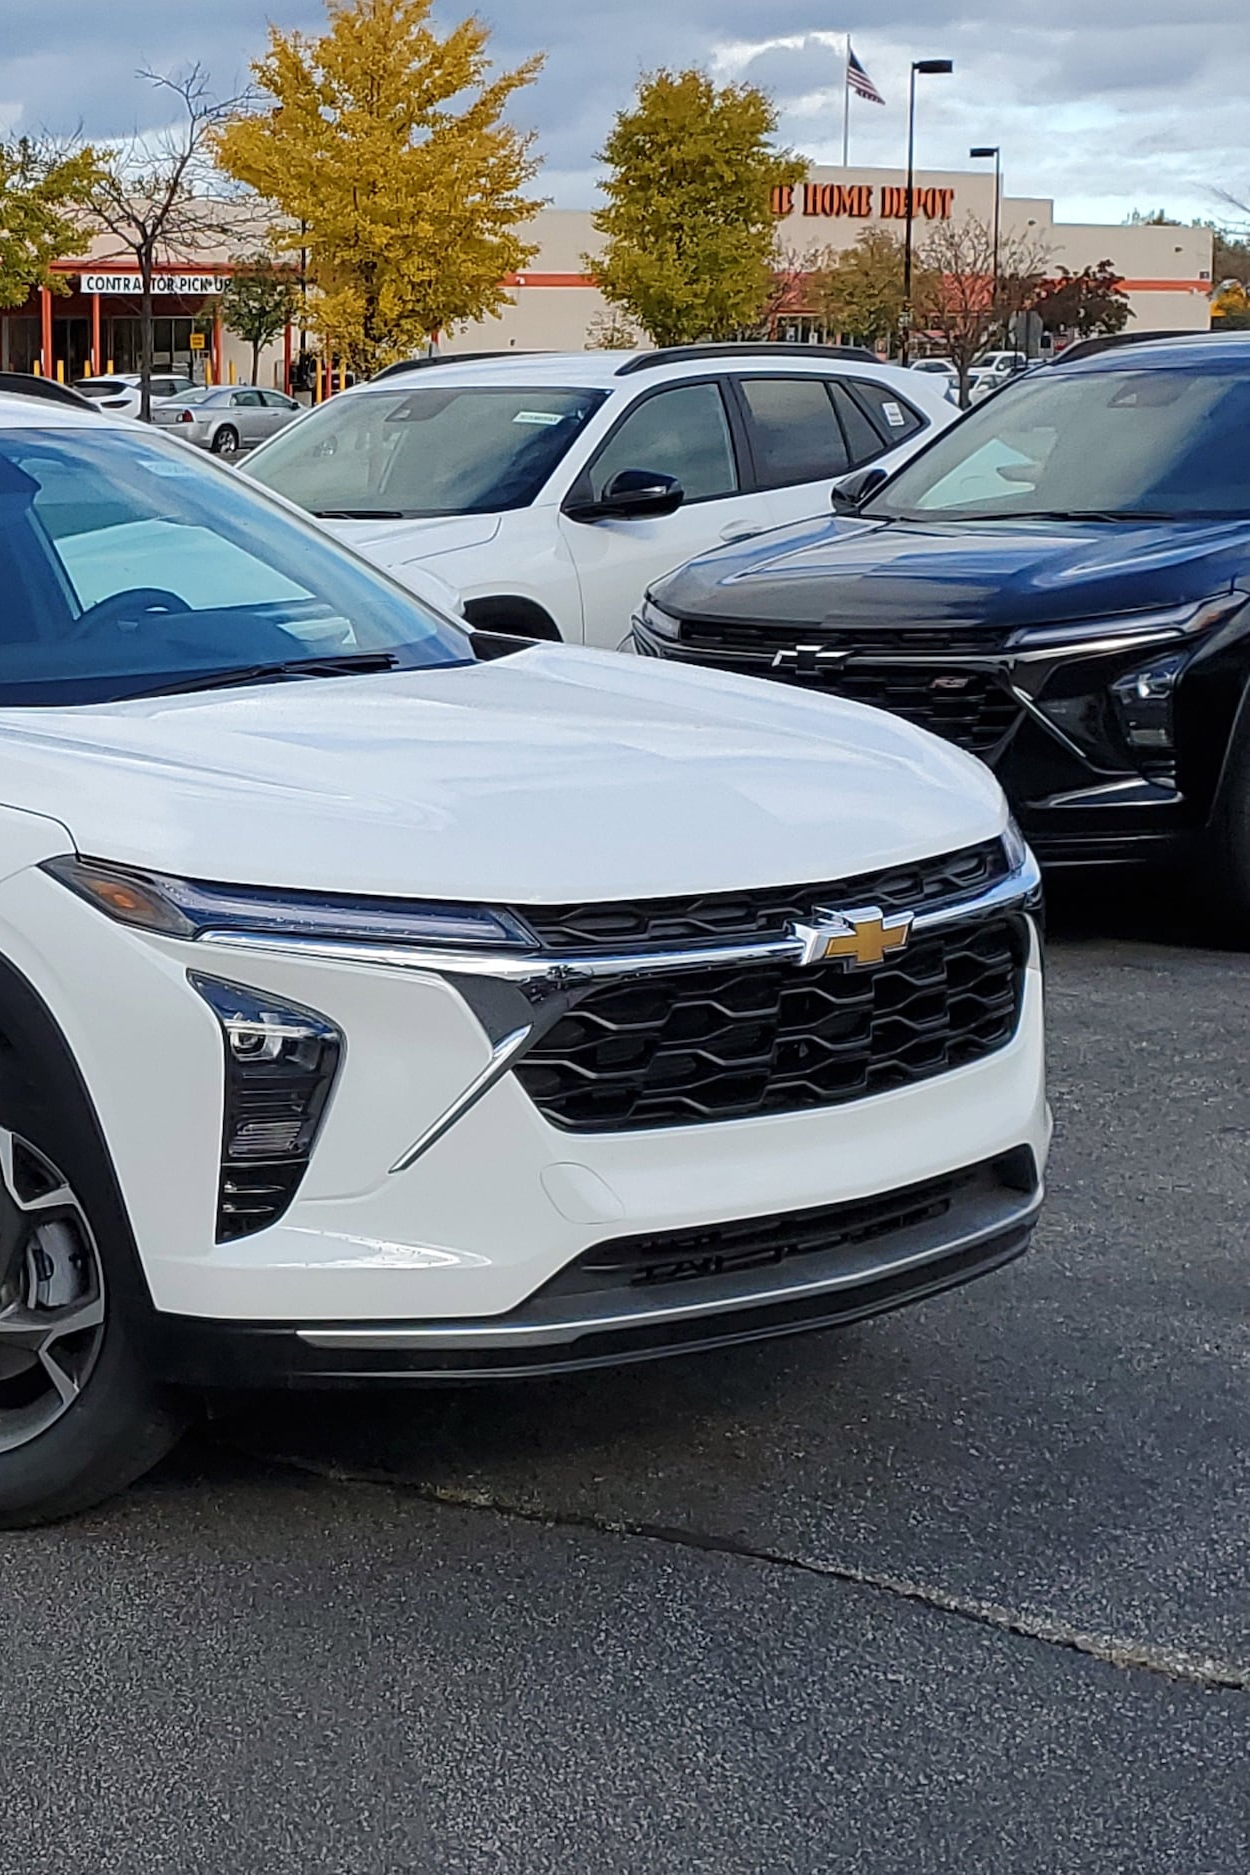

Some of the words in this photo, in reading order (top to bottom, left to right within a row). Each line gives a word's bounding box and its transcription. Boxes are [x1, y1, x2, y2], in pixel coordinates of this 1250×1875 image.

[803, 183, 873, 217] HOME
[881, 187, 954, 219] DEPOT
[86, 276, 174, 292] CONTRATOR
